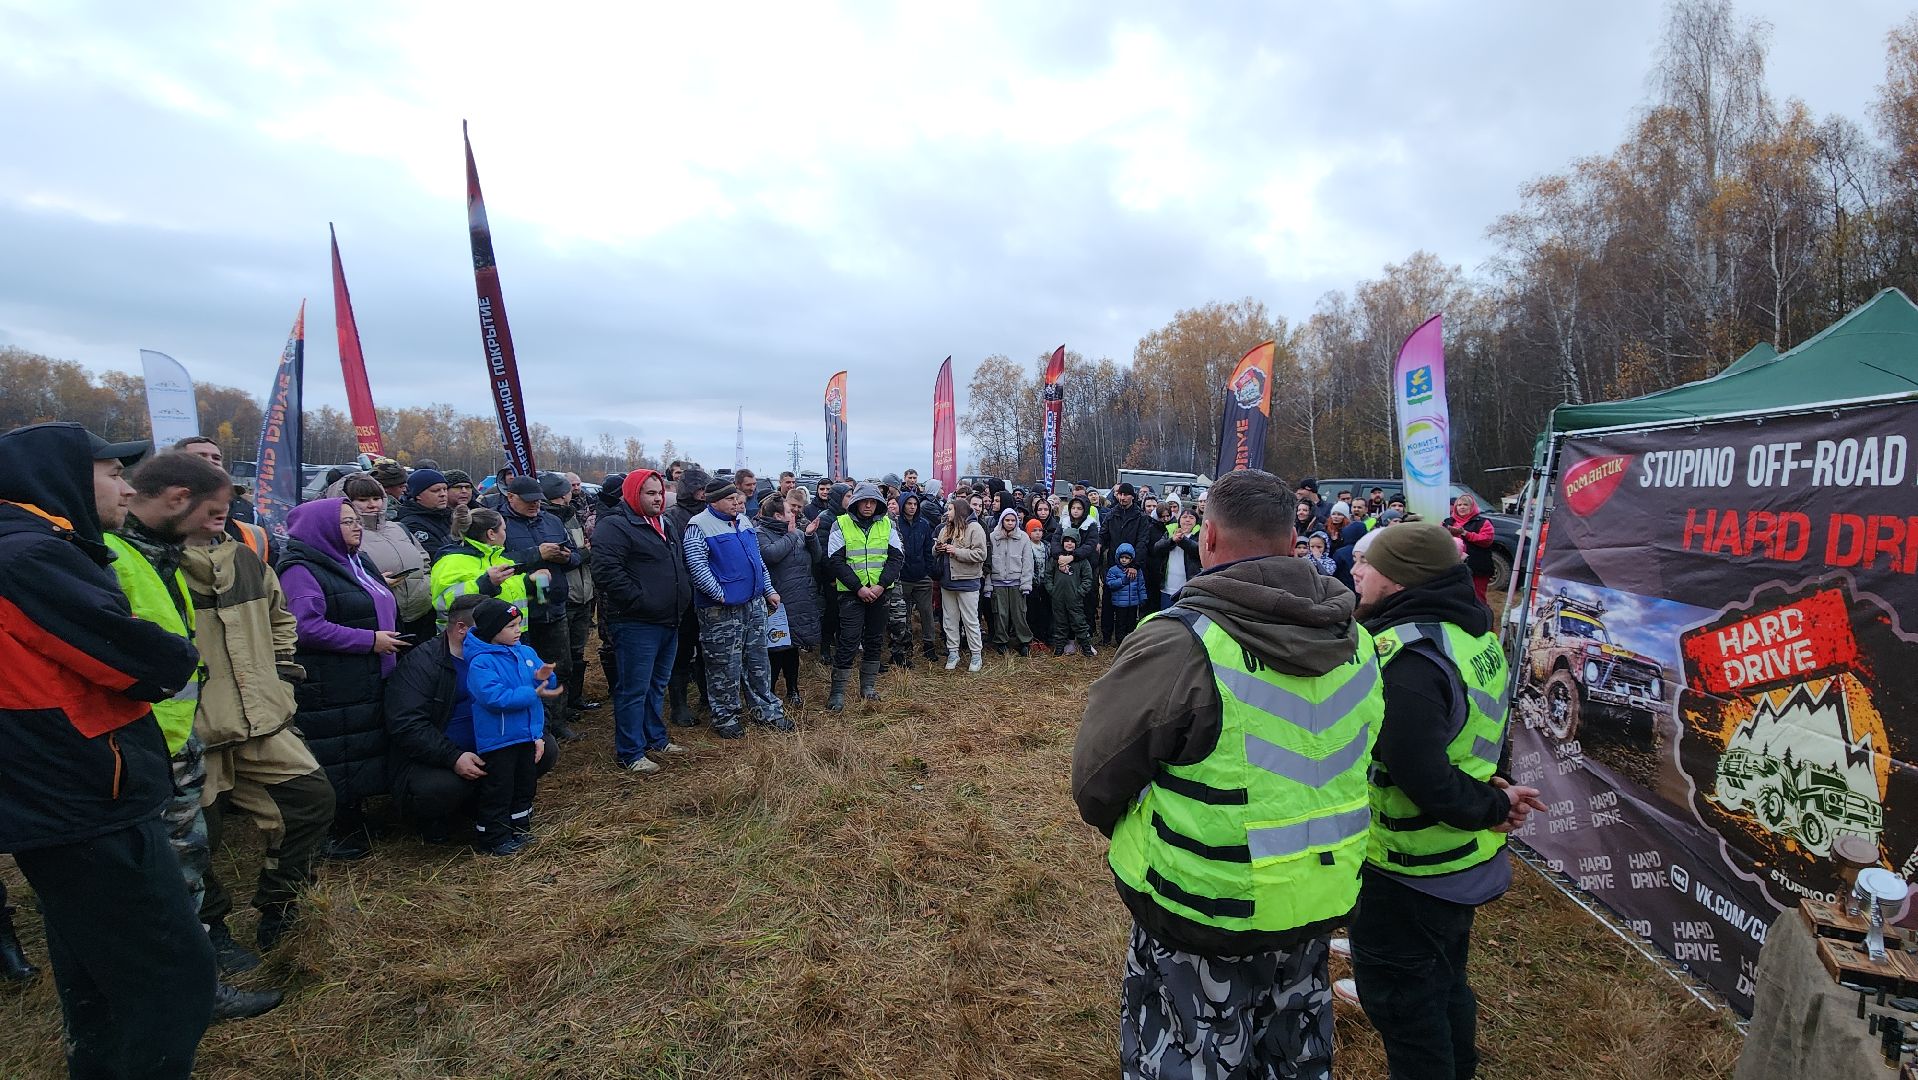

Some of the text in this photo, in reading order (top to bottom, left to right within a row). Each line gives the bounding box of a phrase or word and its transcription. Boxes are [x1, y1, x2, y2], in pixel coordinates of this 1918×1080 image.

[478, 296, 506, 376] ПОКРЫТИЕ
[1639, 435, 1907, 488] STUPINO OFF-ROAD
[1683, 507, 1918, 575] HARD DRI
[1718, 608, 1804, 657] HARD
[1722, 638, 1817, 688] DRIVE
[1519, 752, 1541, 770] HARD
[1520, 766, 1544, 785] DRIVE
[1549, 800, 1574, 817] HARD
[1588, 791, 1618, 810] HARD
[1550, 816, 1577, 833] DRIVE
[1591, 809, 1621, 828] DRIVE
[1578, 855, 1612, 872] HARD
[1628, 850, 1661, 869] HARD
[1580, 873, 1615, 891] DRIVE
[1630, 871, 1670, 889] DRIVE
[1770, 869, 1824, 901] STUPINO
[1696, 880, 1769, 945] VK.COM/CL
[1672, 921, 1715, 940] HARD
[1674, 942, 1722, 962] DRIVE
